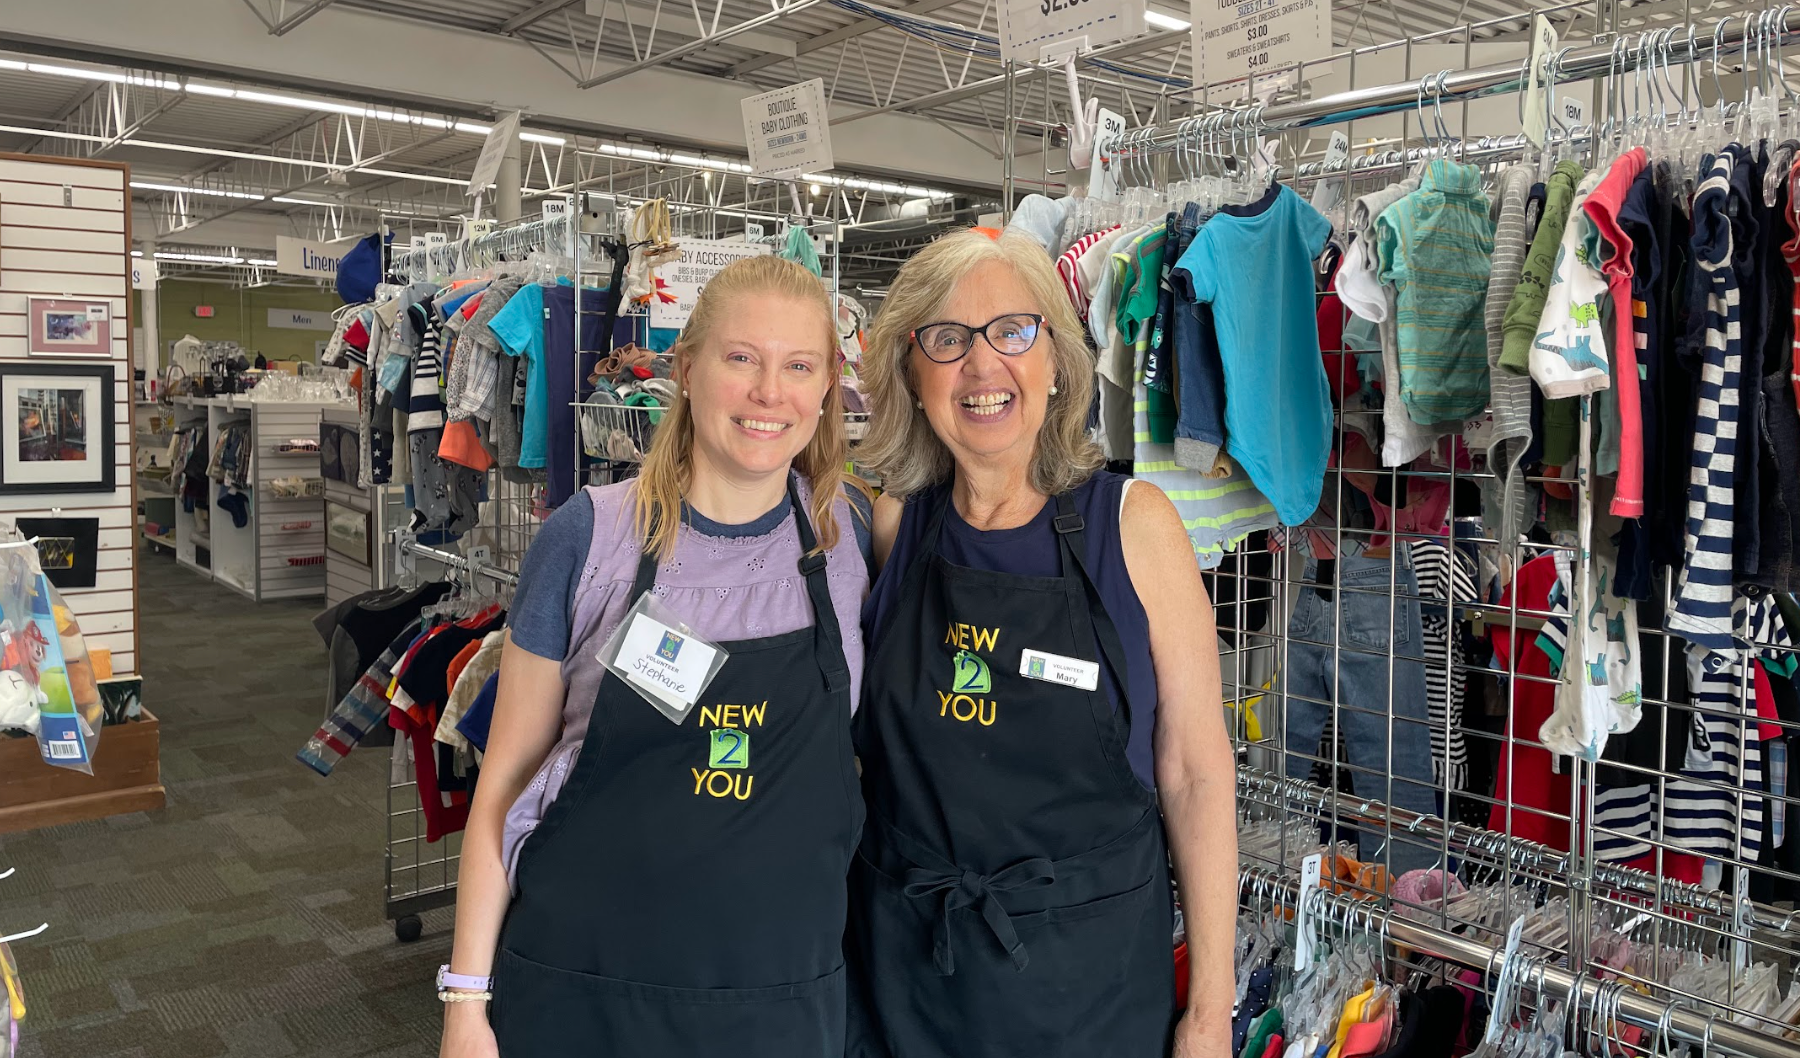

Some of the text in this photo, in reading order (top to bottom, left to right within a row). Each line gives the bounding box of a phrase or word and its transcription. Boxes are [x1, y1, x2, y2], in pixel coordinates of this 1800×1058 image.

[1238, 3, 1254, 16] SIZES
[1281, 2, 1300, 15] SKIRTS
[1247, 24, 1268, 41] $3.00
[1226, 33, 1291, 60] SWEATERS & SWEATSHIRTS
[1248, 52, 1269, 69] $4.00
[767, 97, 797, 117] BOUTIQUE
[1565, 104, 1581, 122] 18M
[761, 112, 809, 135] BABY CLOTHING
[1104, 117, 1121, 135] 3M
[545, 203, 565, 214] 18M
[473, 224, 487, 233] 12M
[749, 226, 760, 236] 6M
[292, 315, 312, 325] Men
[474, 549, 485, 558] 4T
[667, 632, 682, 643] NEW
[944, 621, 1000, 652] NEW
[661, 649, 675, 659] YOU
[645, 653, 680, 674] VOLUNTEER
[1053, 663, 1085, 674] VOLUNTEER
[632, 658, 687, 693] Stephanie
[960, 657, 984, 690] 2
[1056, 672, 1078, 685] Mary
[699, 700, 769, 729] NEW
[937, 690, 997, 726] YOU
[717, 732, 743, 764] 2
[691, 767, 754, 801] YOU
[1307, 860, 1317, 875] 3T
